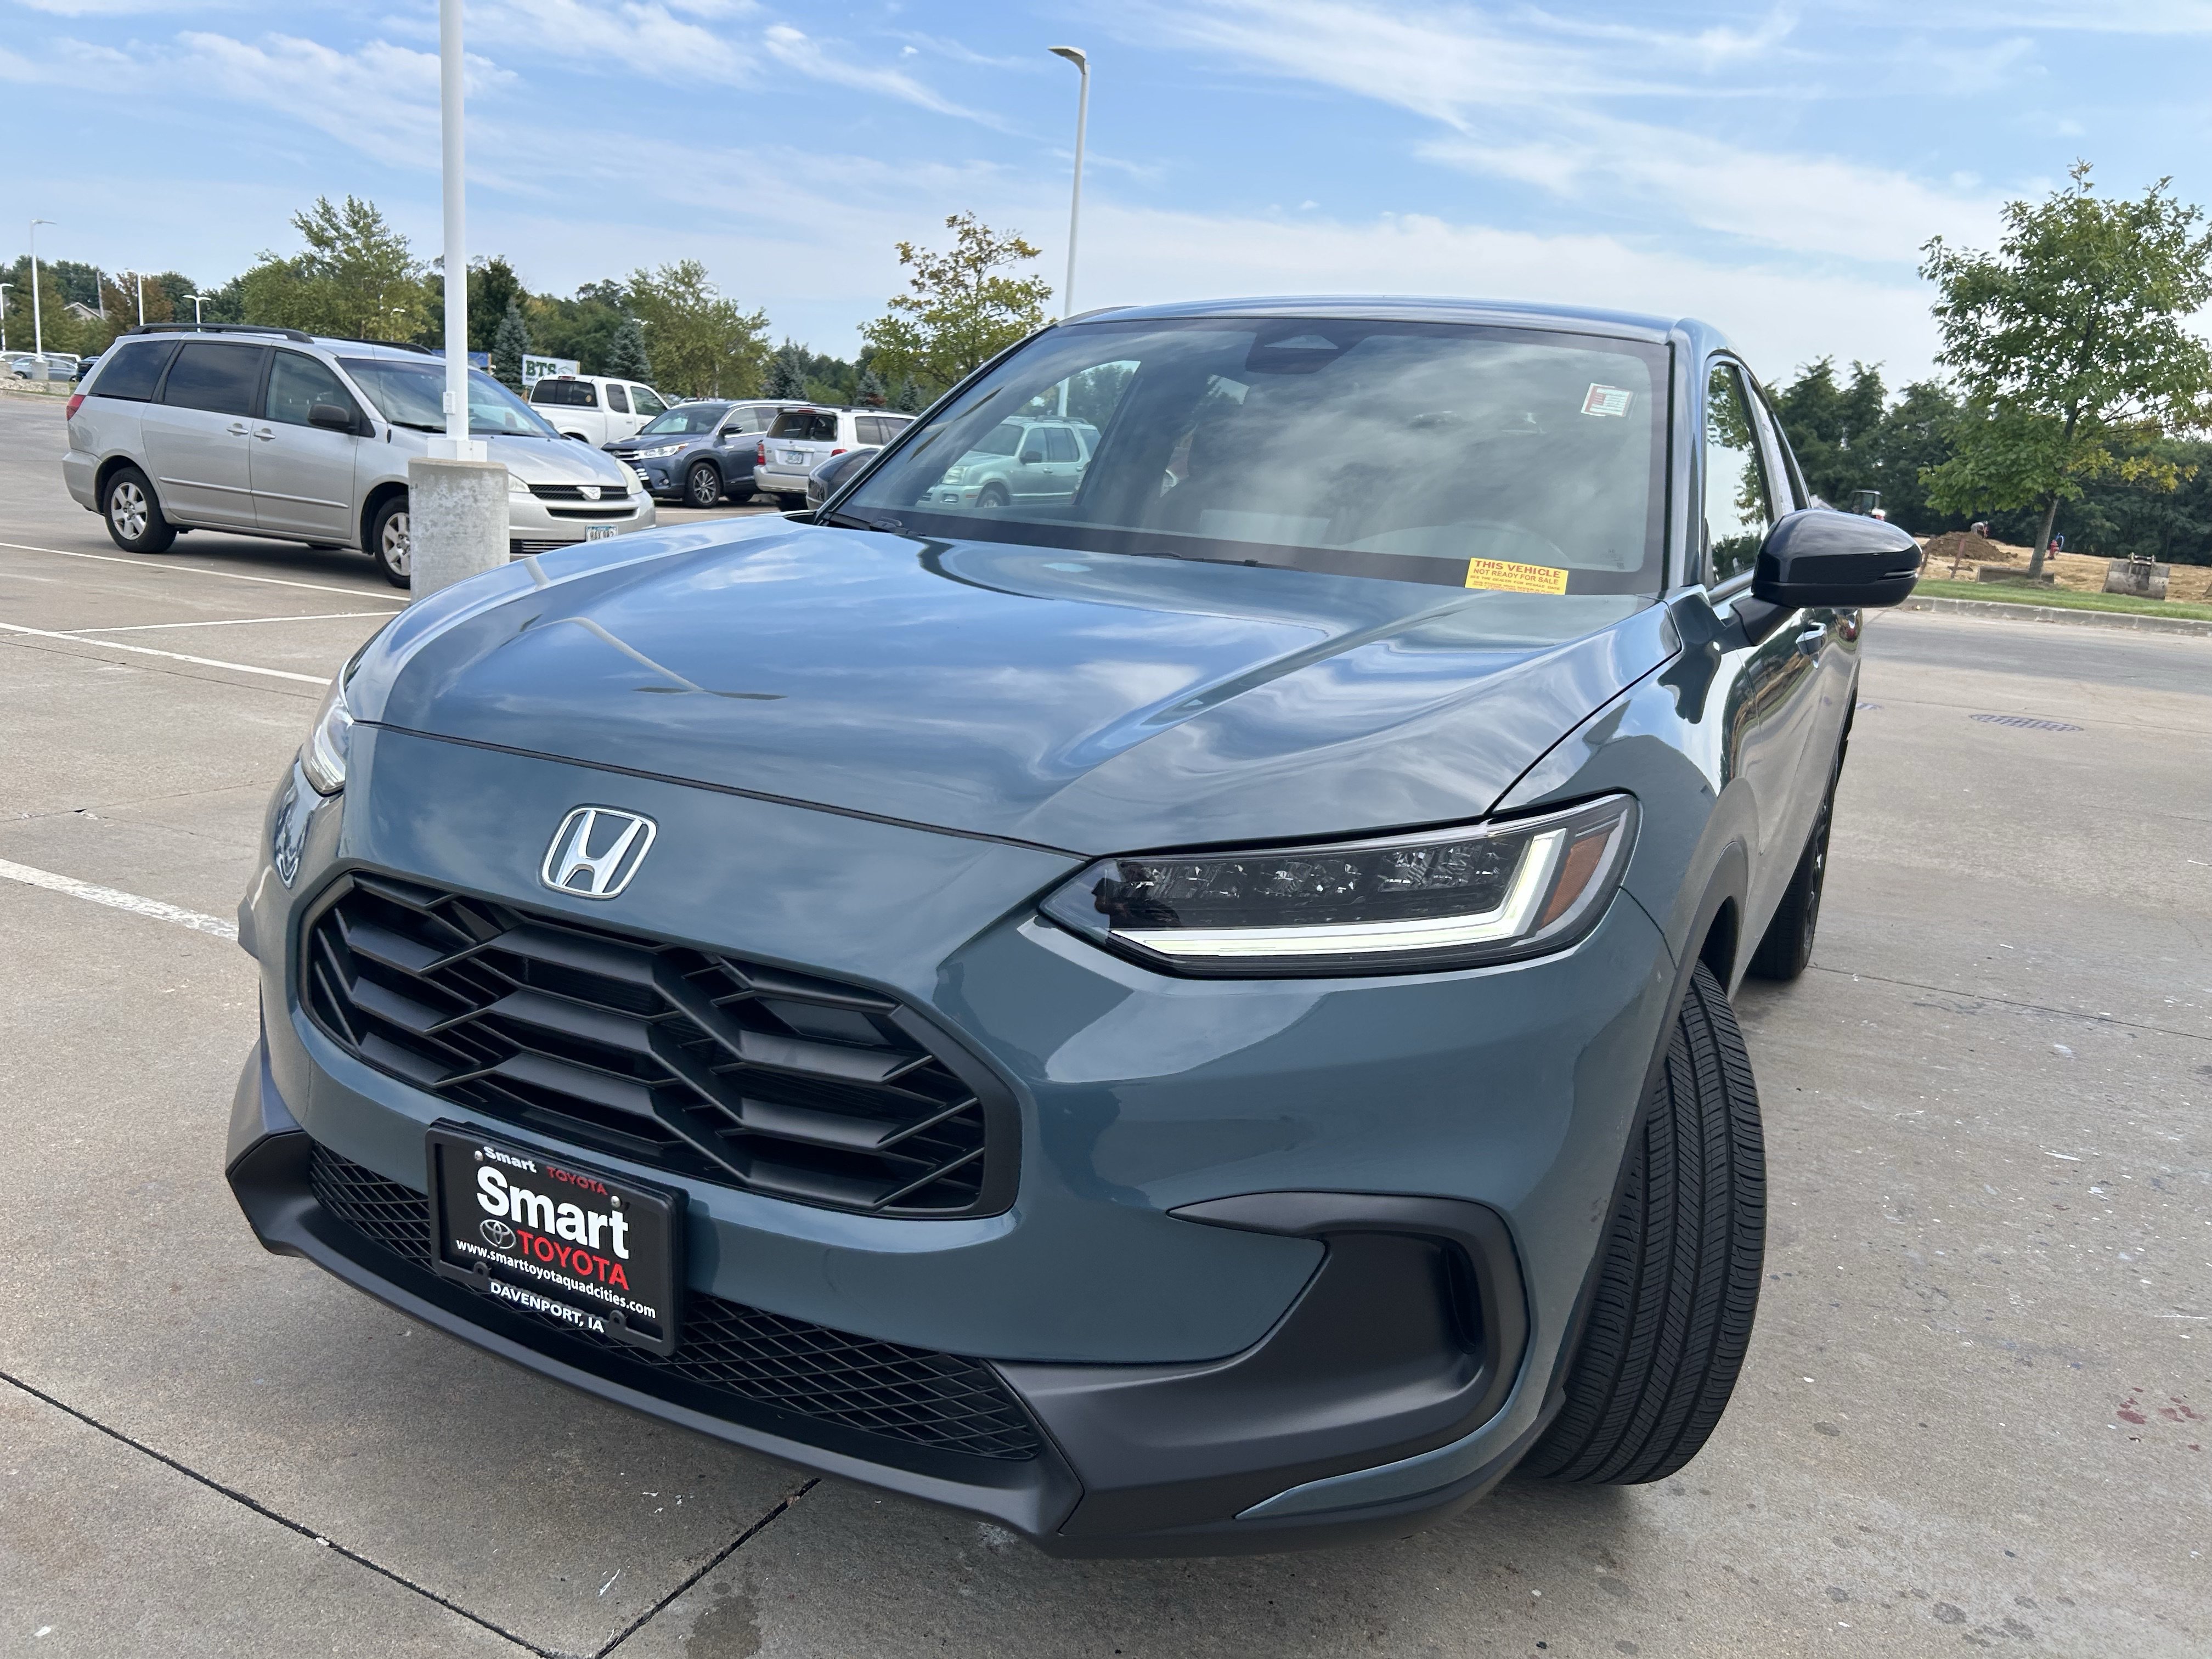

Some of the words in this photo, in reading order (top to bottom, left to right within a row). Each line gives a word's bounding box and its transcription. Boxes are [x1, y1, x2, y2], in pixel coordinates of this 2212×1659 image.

[1475, 560, 1503, 569] THIS
[1508, 564, 1561, 578] VEHICLE
[1538, 577, 1559, 585] SALE
[483, 1146, 537, 1173] Smart
[546, 1166, 608, 1195] TOYOTA
[477, 1166, 629, 1260] Smart
[456, 1239, 656, 1319] www.smarttoyotaquadcities.com
[517, 1230, 630, 1291] TOYOTA
[490, 1282, 584, 1327] DAVENPORT,
[588, 1317, 604, 1333] IA
